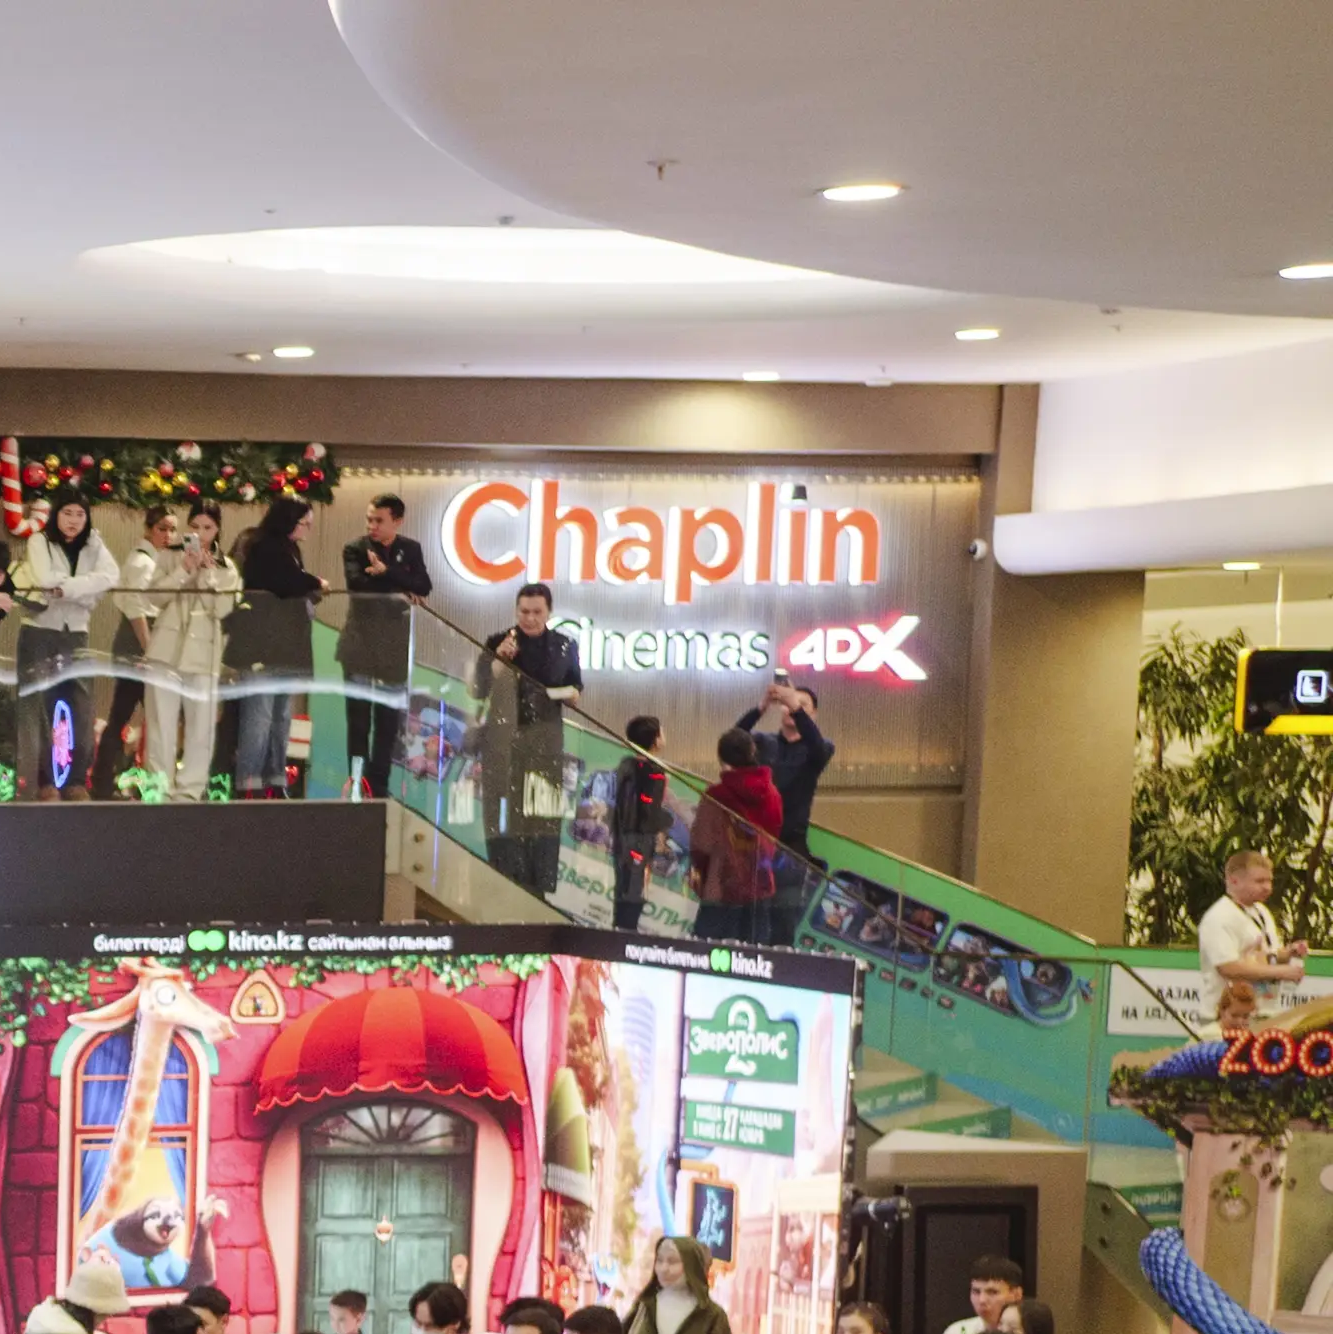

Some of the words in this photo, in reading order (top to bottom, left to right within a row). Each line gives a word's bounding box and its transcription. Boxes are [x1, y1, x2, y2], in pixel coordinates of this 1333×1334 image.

[441, 479, 881, 605] Chaplin
[546, 615, 770, 671] inemas
[790, 615, 928, 682] 4DX
[93, 934, 186, 954] билеттерді
[228, 929, 305, 951] kino.kz
[731, 951, 773, 979] kino.kz
[1121, 1006, 1138, 1020] НА
